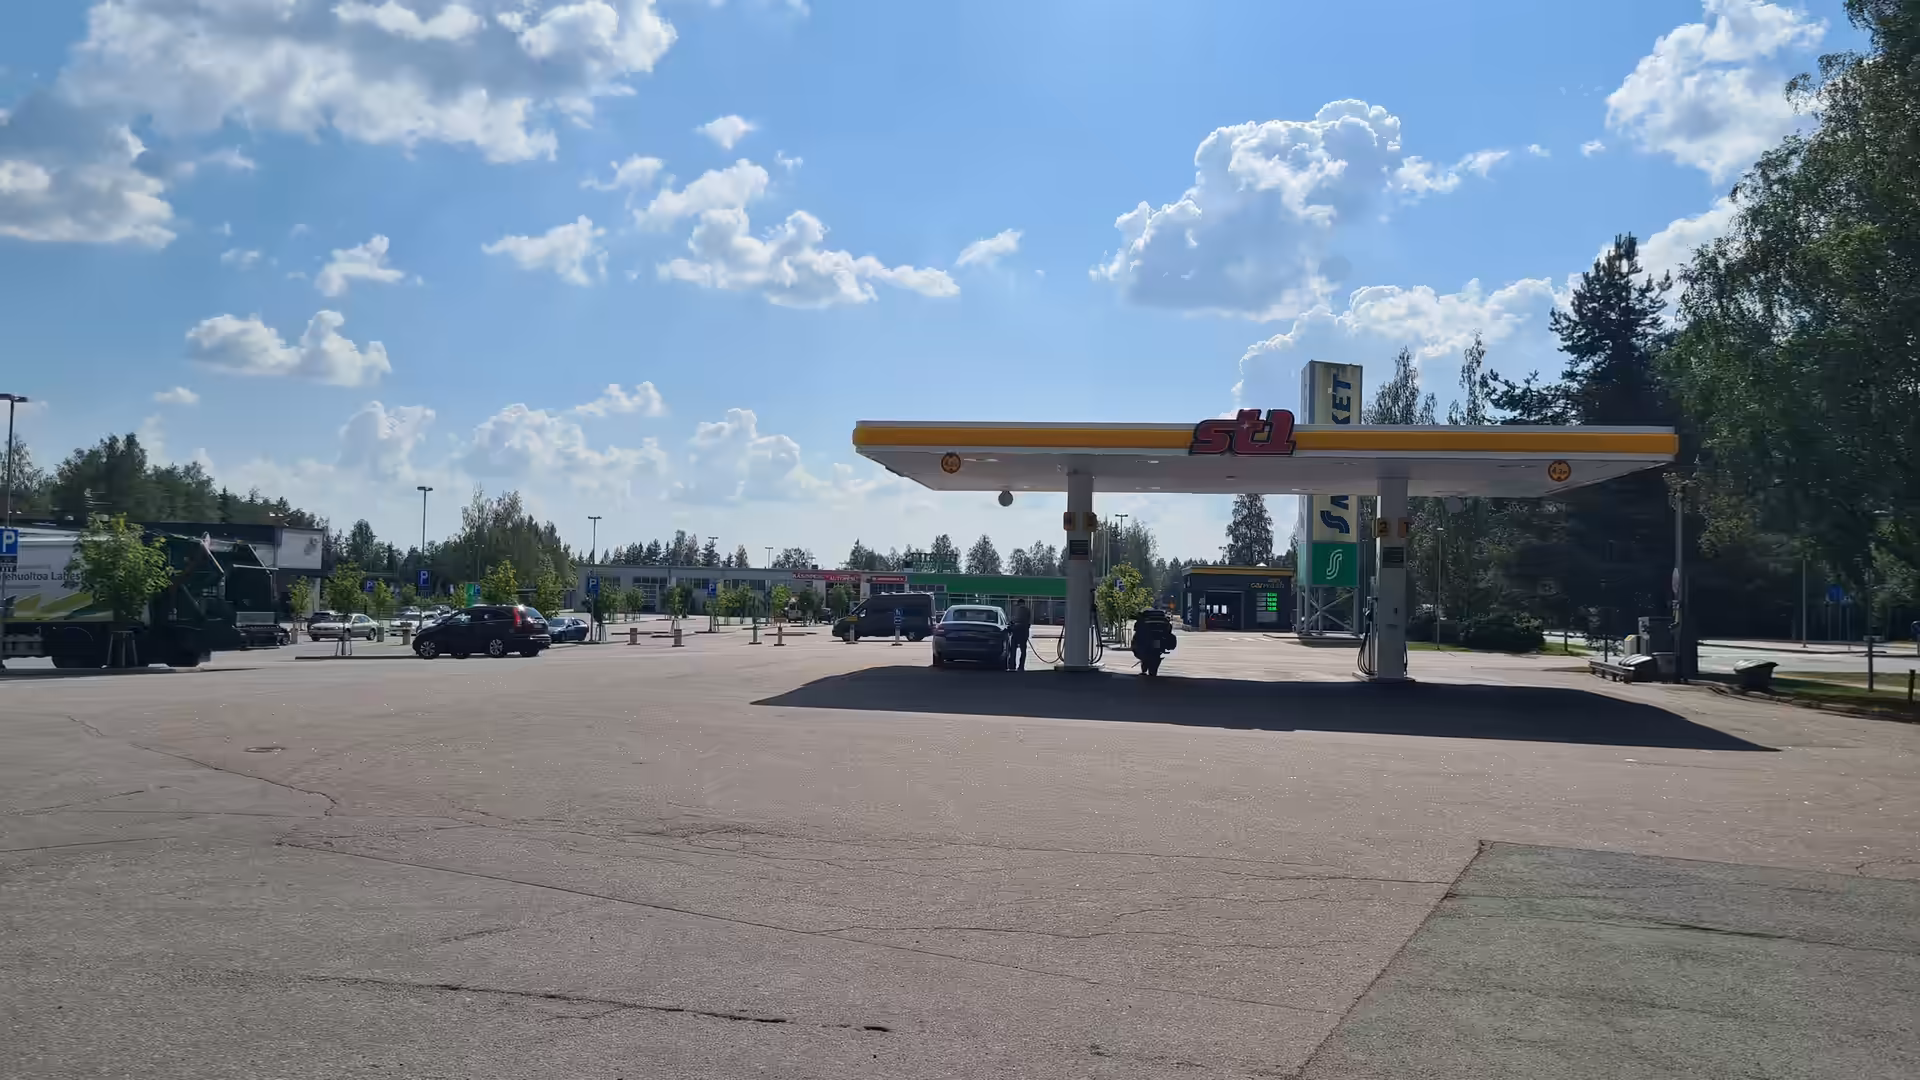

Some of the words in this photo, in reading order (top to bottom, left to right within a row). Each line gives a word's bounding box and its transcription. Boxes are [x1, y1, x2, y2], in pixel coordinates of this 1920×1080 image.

[3, 531, 15, 552] P
[0, 572, 48, 581] ehuoltoa
[420, 570, 428, 585] P
[589, 577, 597, 588] P
